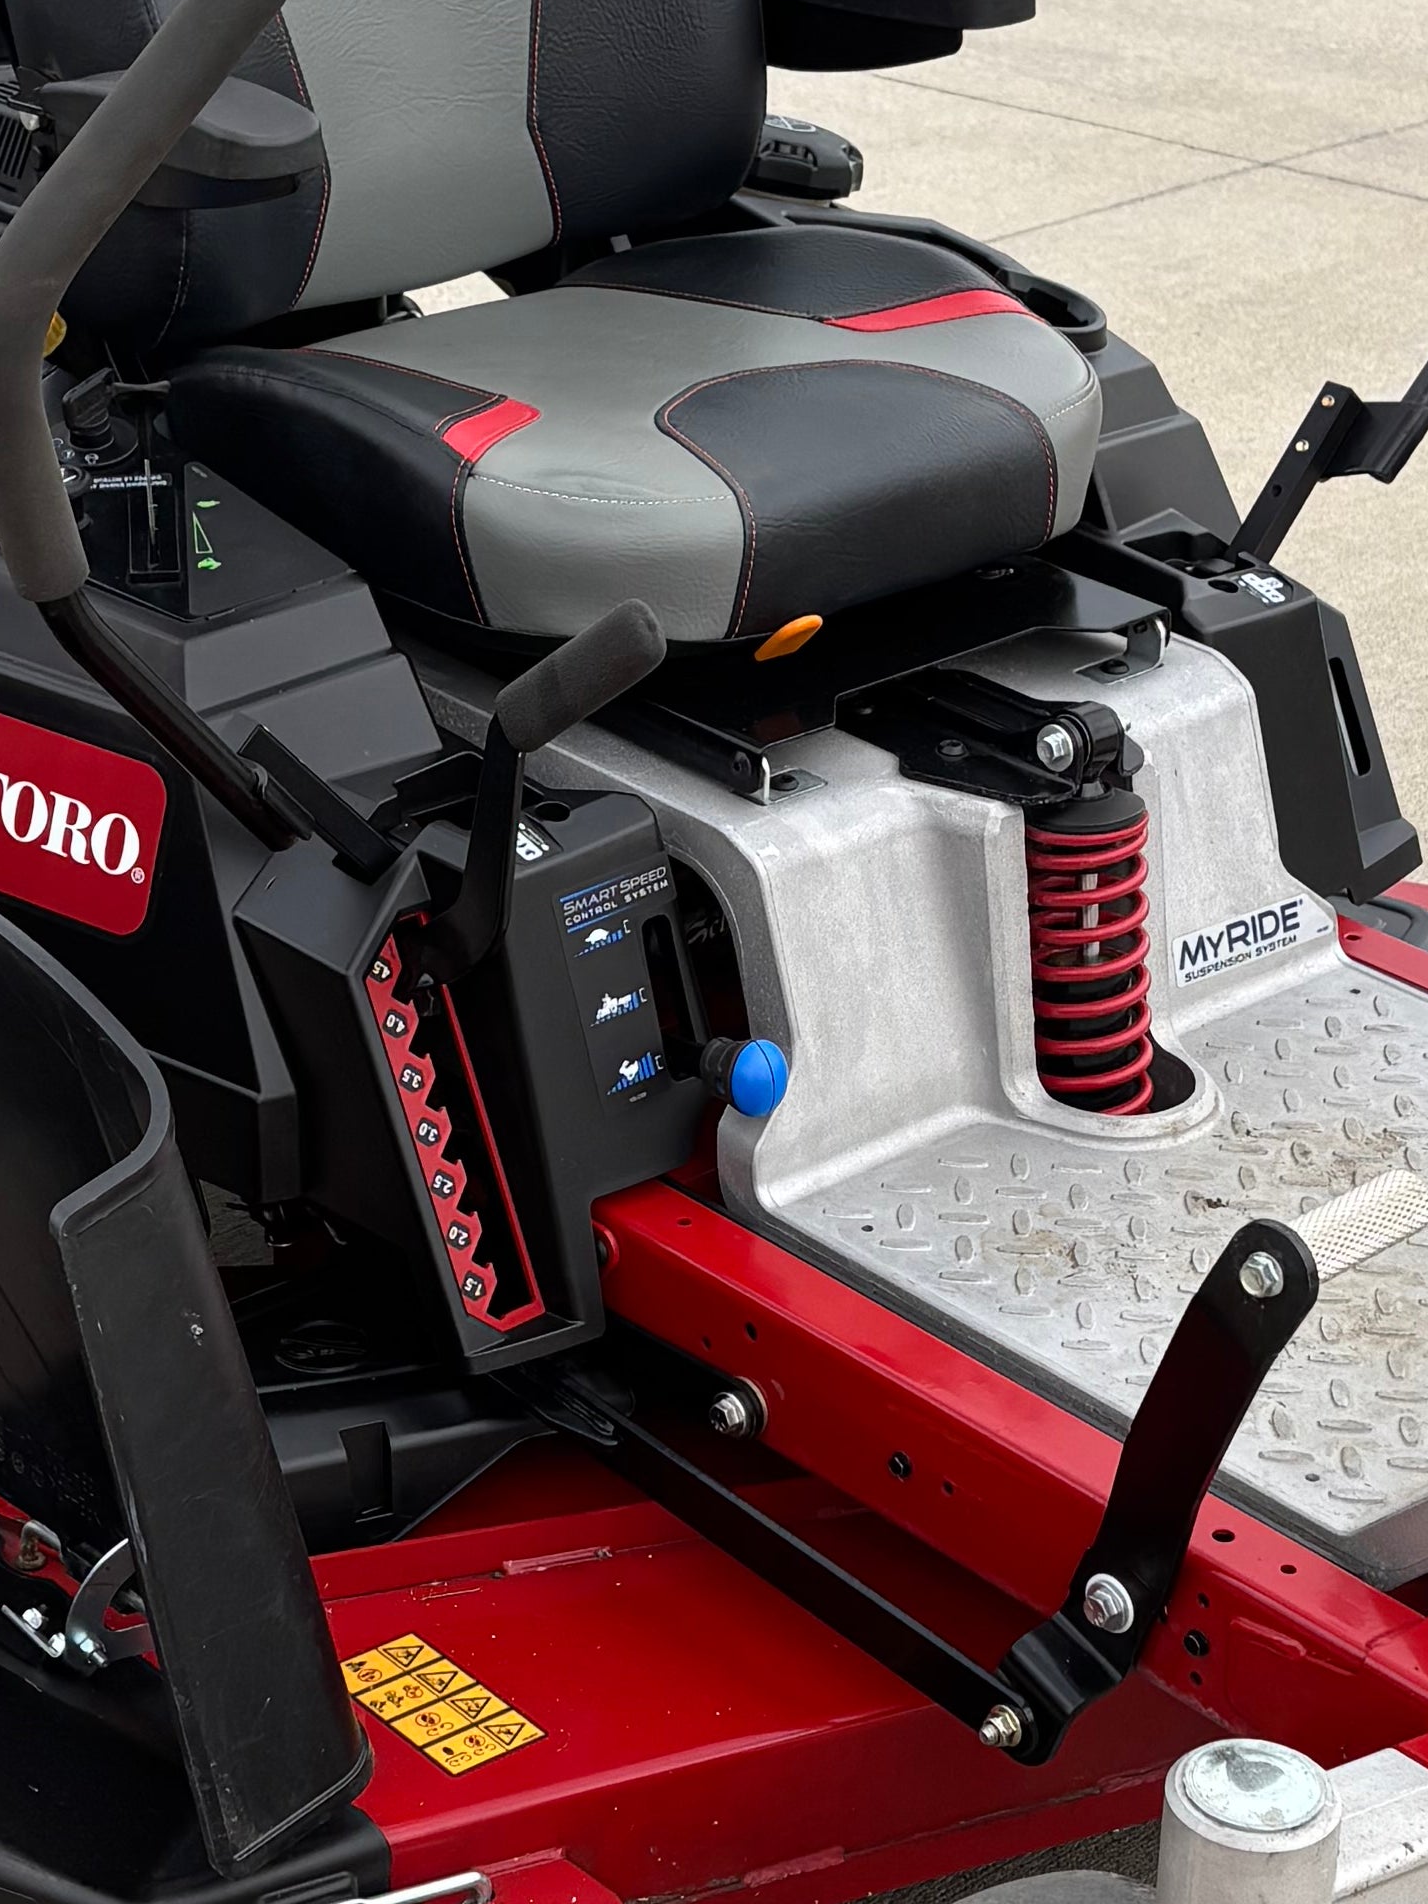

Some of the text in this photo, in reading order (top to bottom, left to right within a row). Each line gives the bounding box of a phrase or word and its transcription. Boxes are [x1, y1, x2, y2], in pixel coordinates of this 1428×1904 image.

[563, 866, 667, 916] SMART SPEED
[565, 879, 669, 926] CONTROL SYSTEM
[1184, 934, 1297, 983] SUSPENSION SYSTEM
[372, 960, 391, 979] 4.5
[385, 1014, 406, 1033] 4.0
[401, 1068, 422, 1089] 3.5
[418, 1122, 438, 1142] 3.0
[432, 1175, 454, 1194] 2.5
[448, 1226, 469, 1245] 2.0
[464, 1277, 483, 1296] 1.5
